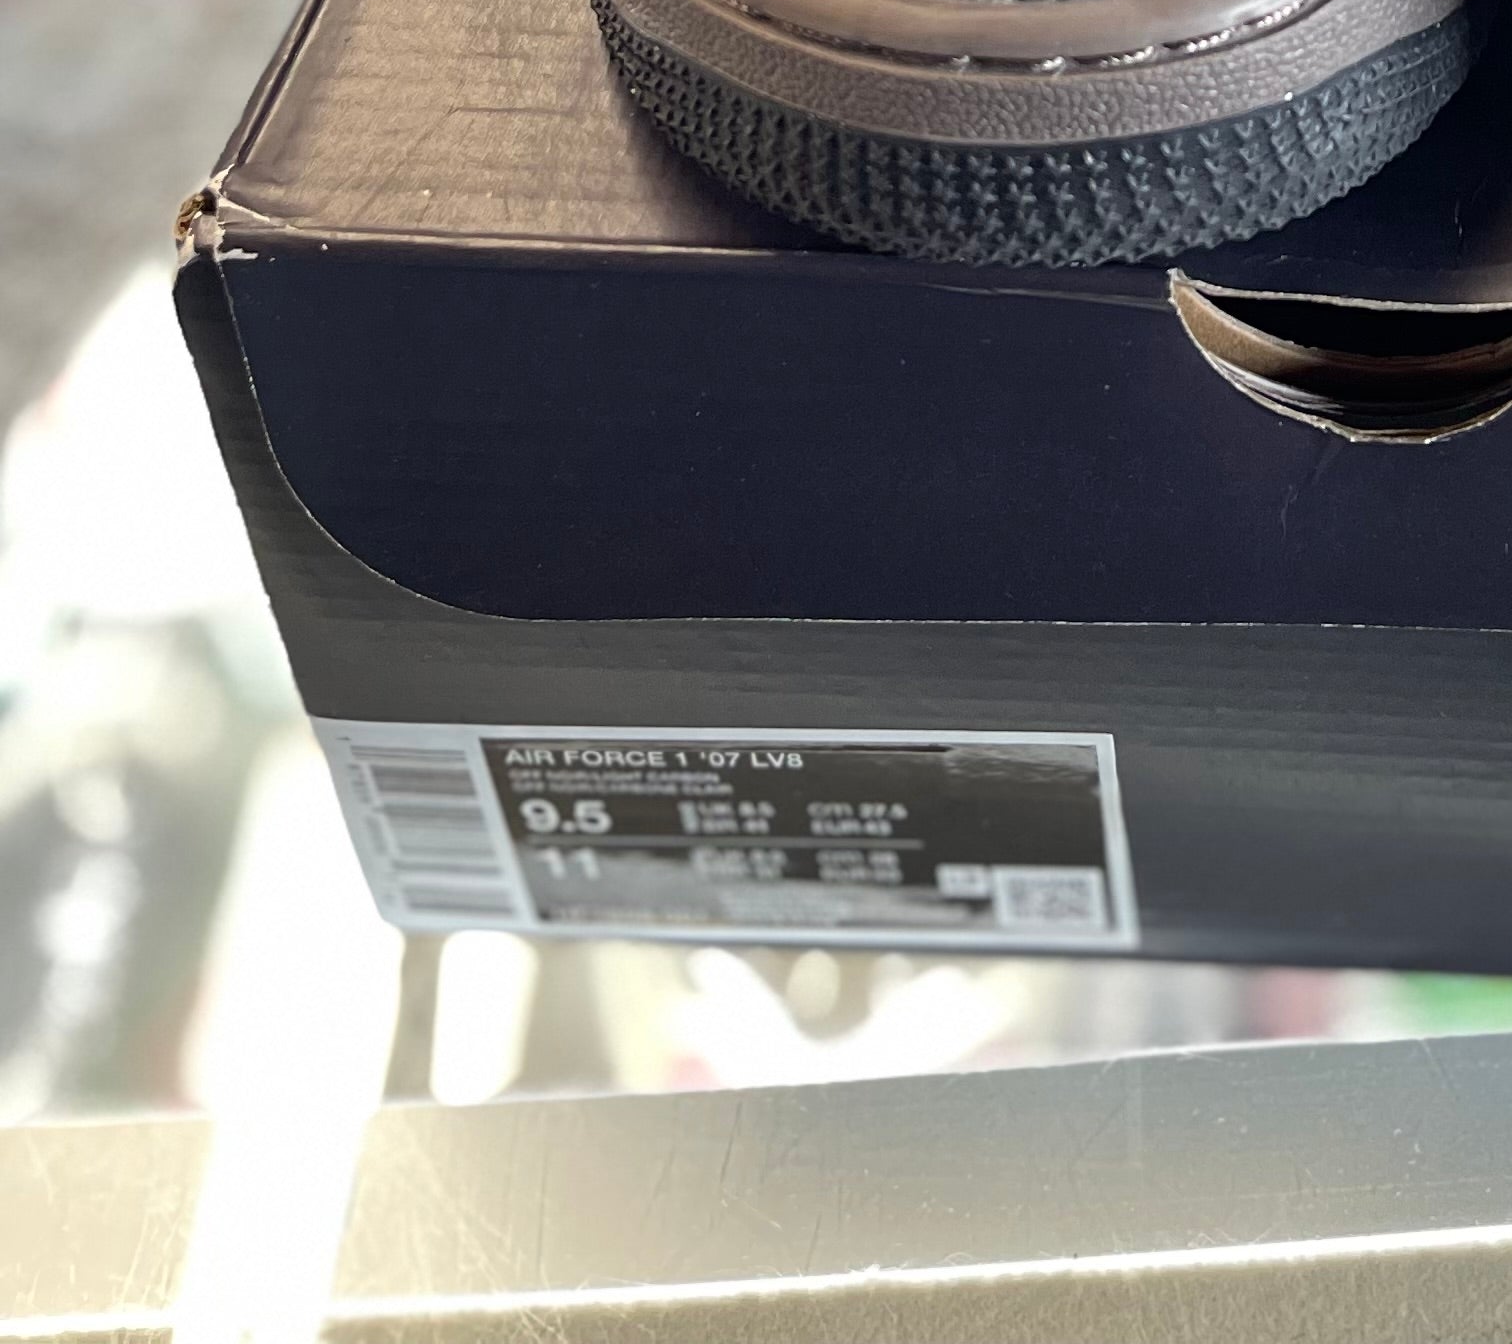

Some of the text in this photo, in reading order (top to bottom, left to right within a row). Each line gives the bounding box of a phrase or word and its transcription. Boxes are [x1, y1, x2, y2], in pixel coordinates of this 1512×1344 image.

[505, 749, 804, 769] AIR FORCE 1 '07 LV8
[519, 798, 613, 834] 9.5
[538, 847, 600, 881] 11
